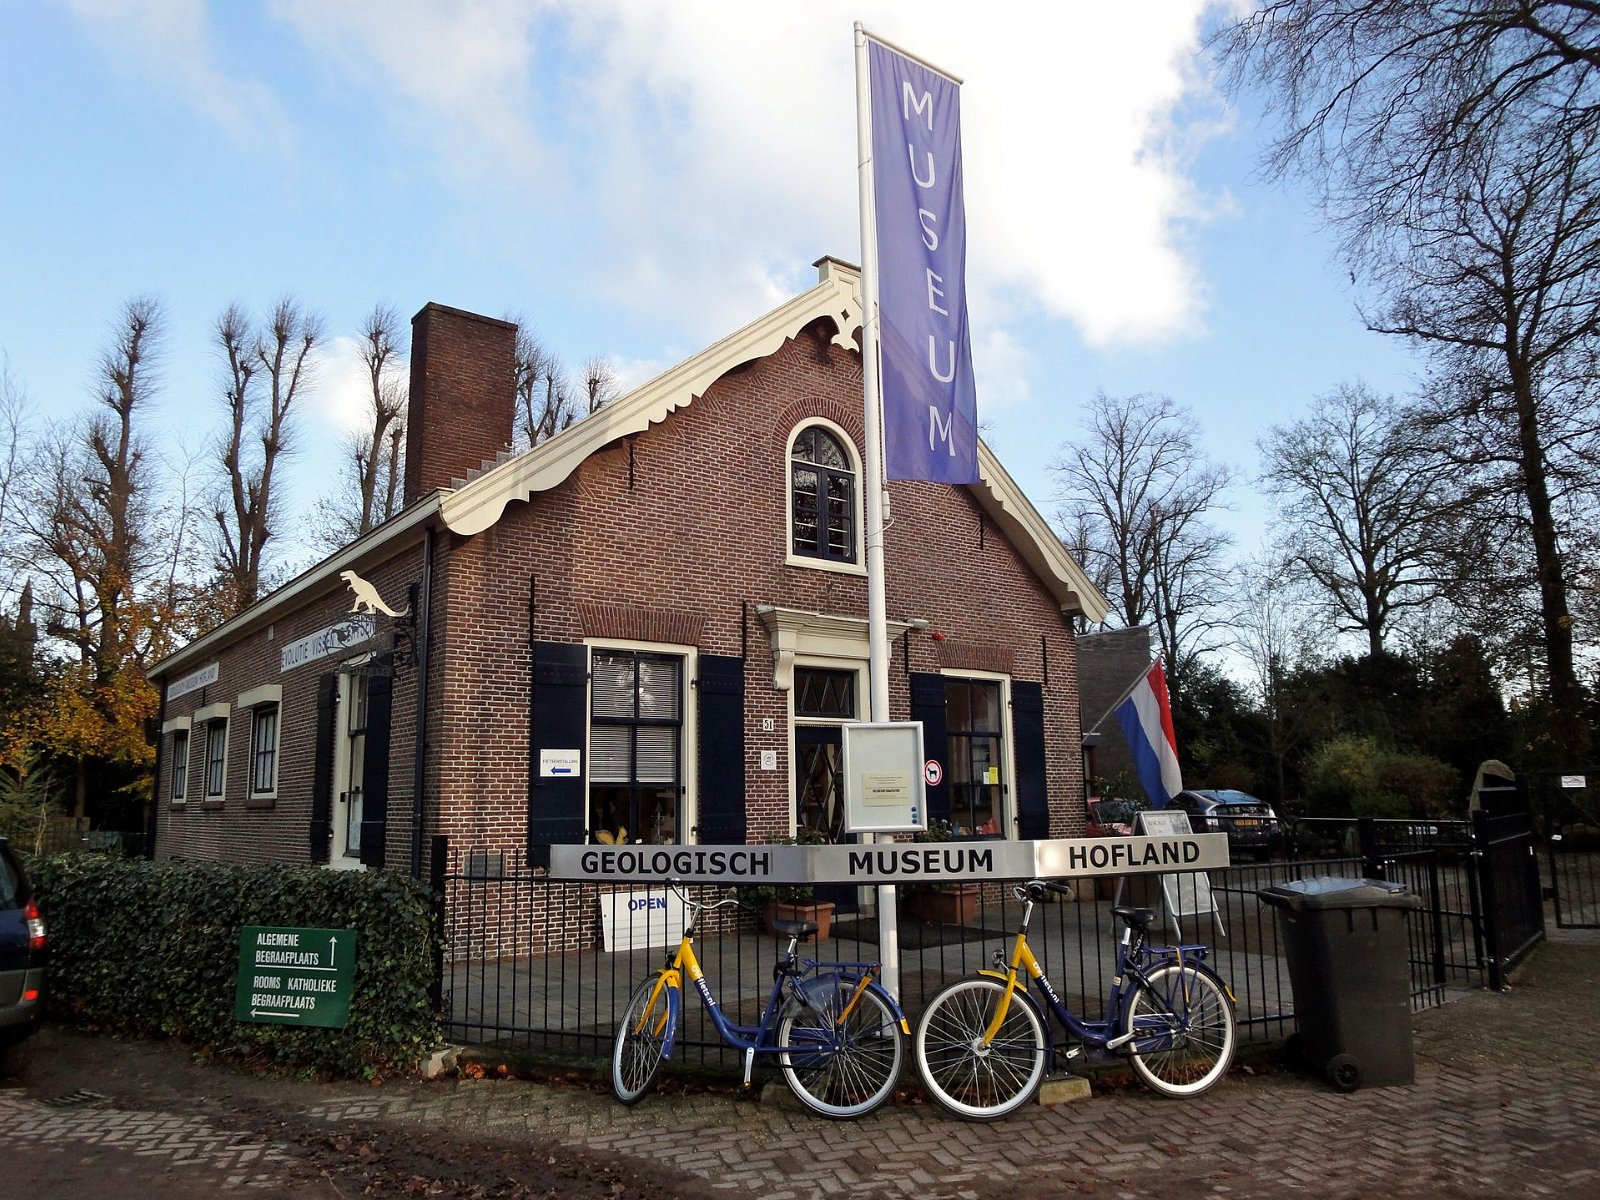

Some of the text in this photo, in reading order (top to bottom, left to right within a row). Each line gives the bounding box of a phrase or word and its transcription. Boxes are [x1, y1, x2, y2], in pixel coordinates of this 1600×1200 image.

[903, 81, 956, 457] MUSEUM
[764, 719, 773, 730] 51
[581, 841, 1200, 876] GEOLOGISCH MUSEUM HOFLAND
[627, 897, 667, 911] OPEN
[256, 933, 300, 947] ALGEMENE
[255, 950, 319, 966] BEGRAAFPLAATS
[253, 976, 337, 993] ROOMS KATHOLIEKE
[251, 993, 316, 1010] BEGRAAFPLAATS
